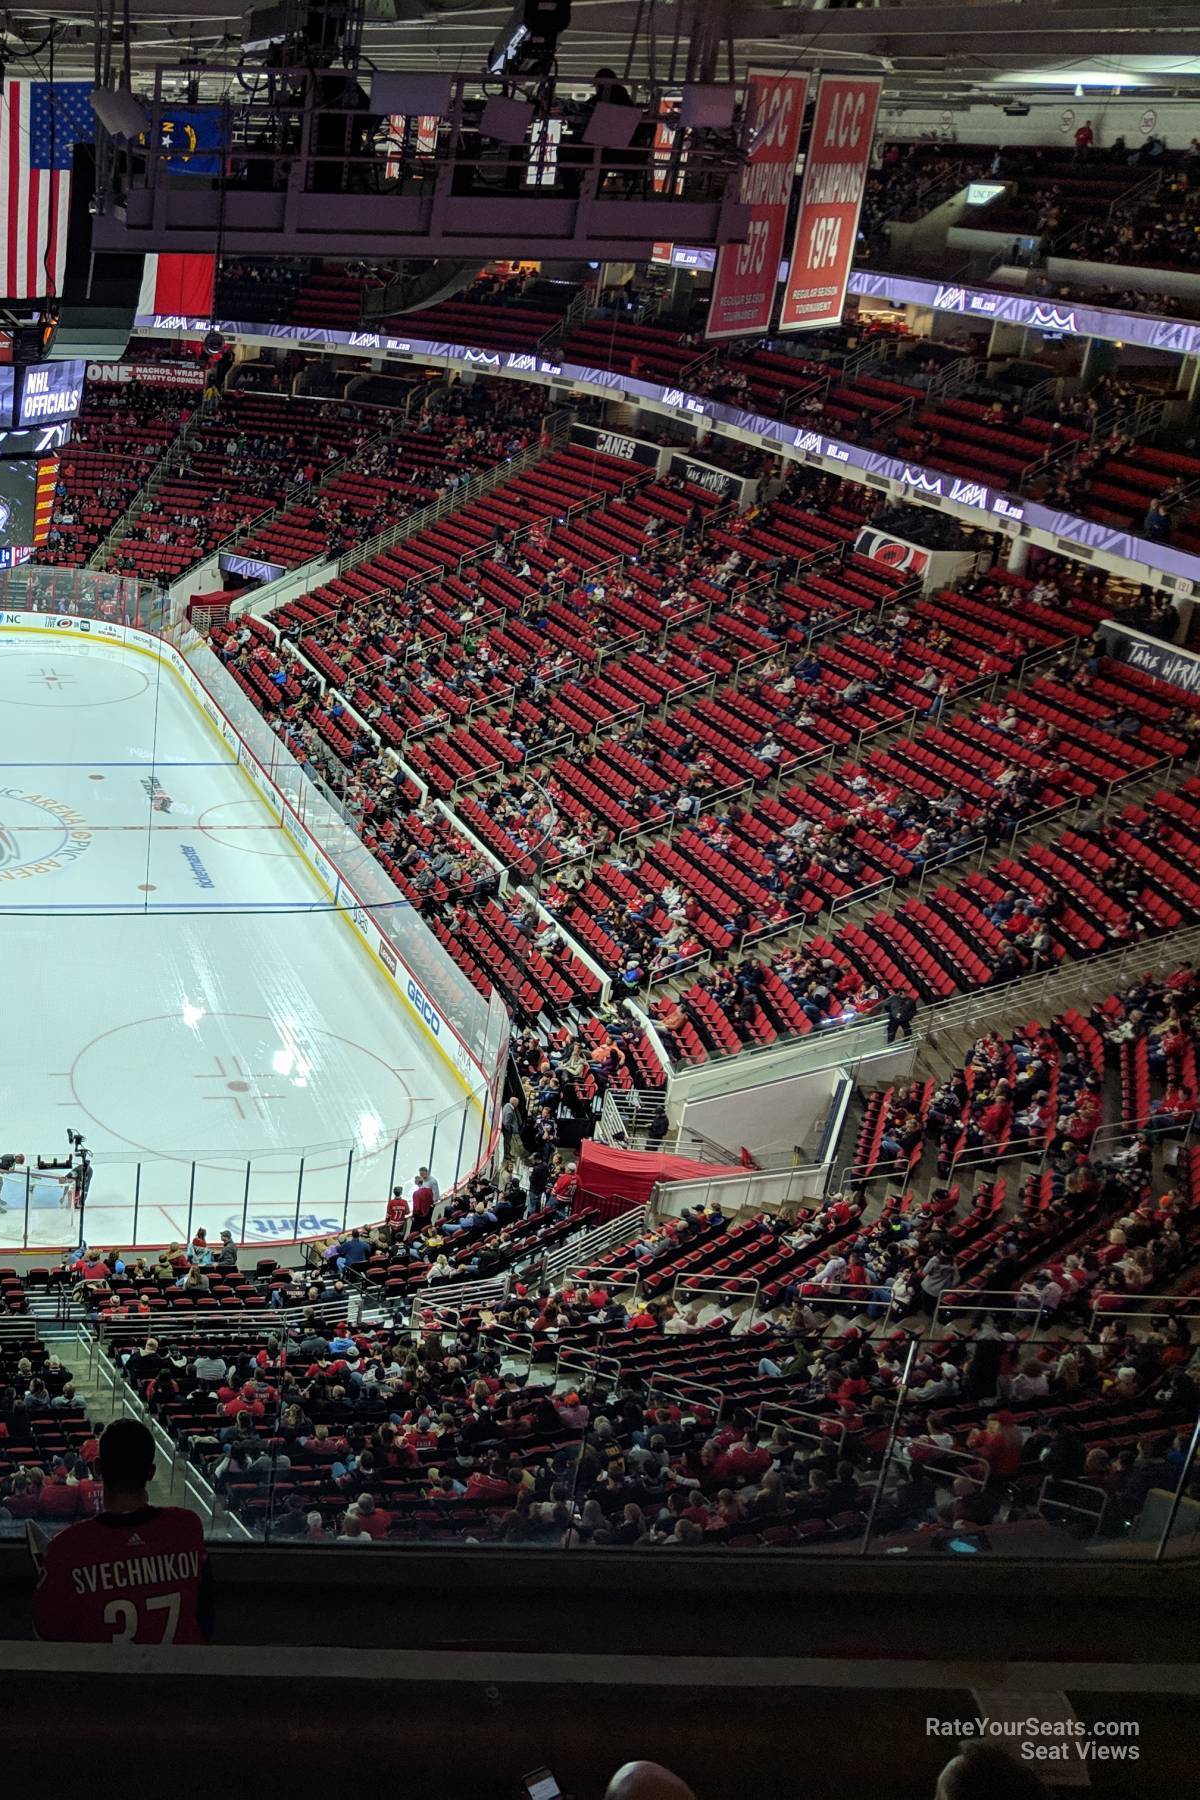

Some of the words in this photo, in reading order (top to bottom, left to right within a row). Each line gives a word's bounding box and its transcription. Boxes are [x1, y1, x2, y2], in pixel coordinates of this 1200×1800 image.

[824, 92, 864, 148] ACC
[740, 163, 793, 204] HAMPIONS
[806, 163, 864, 204] CHAMPIONS
[807, 217, 841, 270] 1974
[27, 372, 50, 394] NHL
[86, 364, 134, 382] ONE
[24, 390, 79, 418] OFFICIALS
[596, 434, 636, 460] CANES
[6, 615, 22, 624] NC
[21, 794, 87, 826] ARENA
[63, 839, 91, 861] PNC
[407, 979, 440, 1036] GEICO
[72, 1552, 199, 1594] SVECHNIKOV
[104, 1592, 182, 1645] 37
